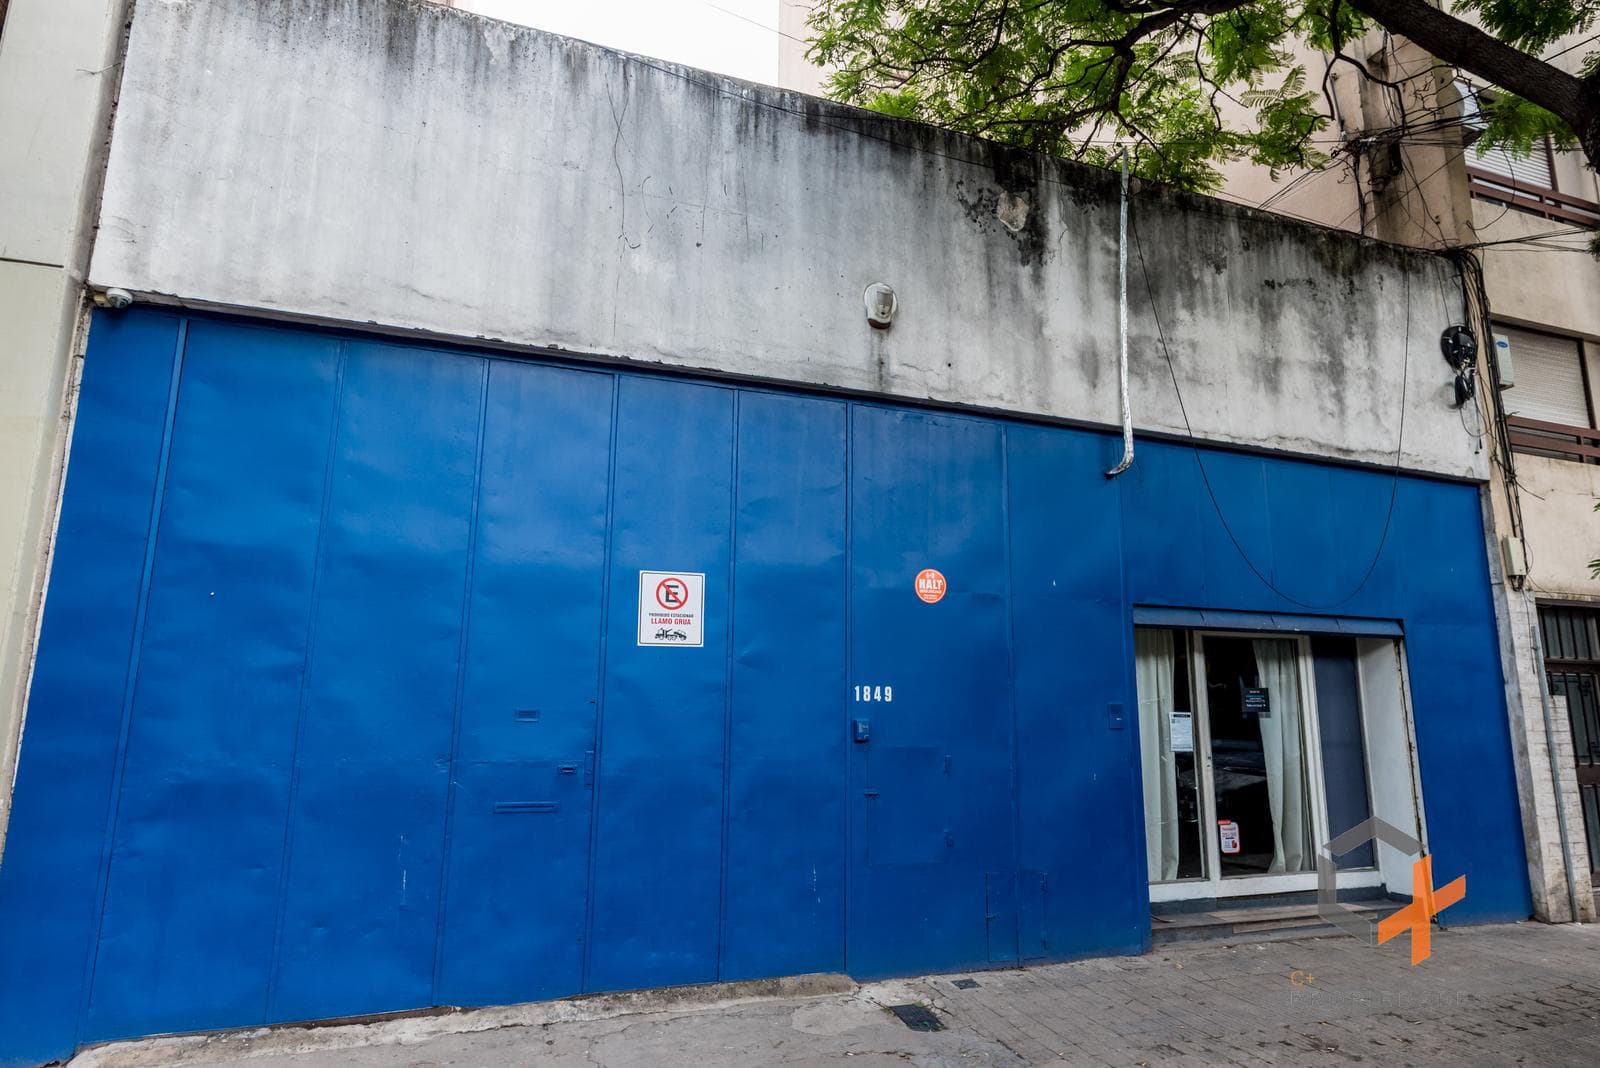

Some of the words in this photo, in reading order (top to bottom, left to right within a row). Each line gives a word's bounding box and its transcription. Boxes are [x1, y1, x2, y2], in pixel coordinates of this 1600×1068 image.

[919, 579, 943, 590] HALT
[651, 617, 673, 625] LLAMO
[854, 685, 892, 702] 1849
